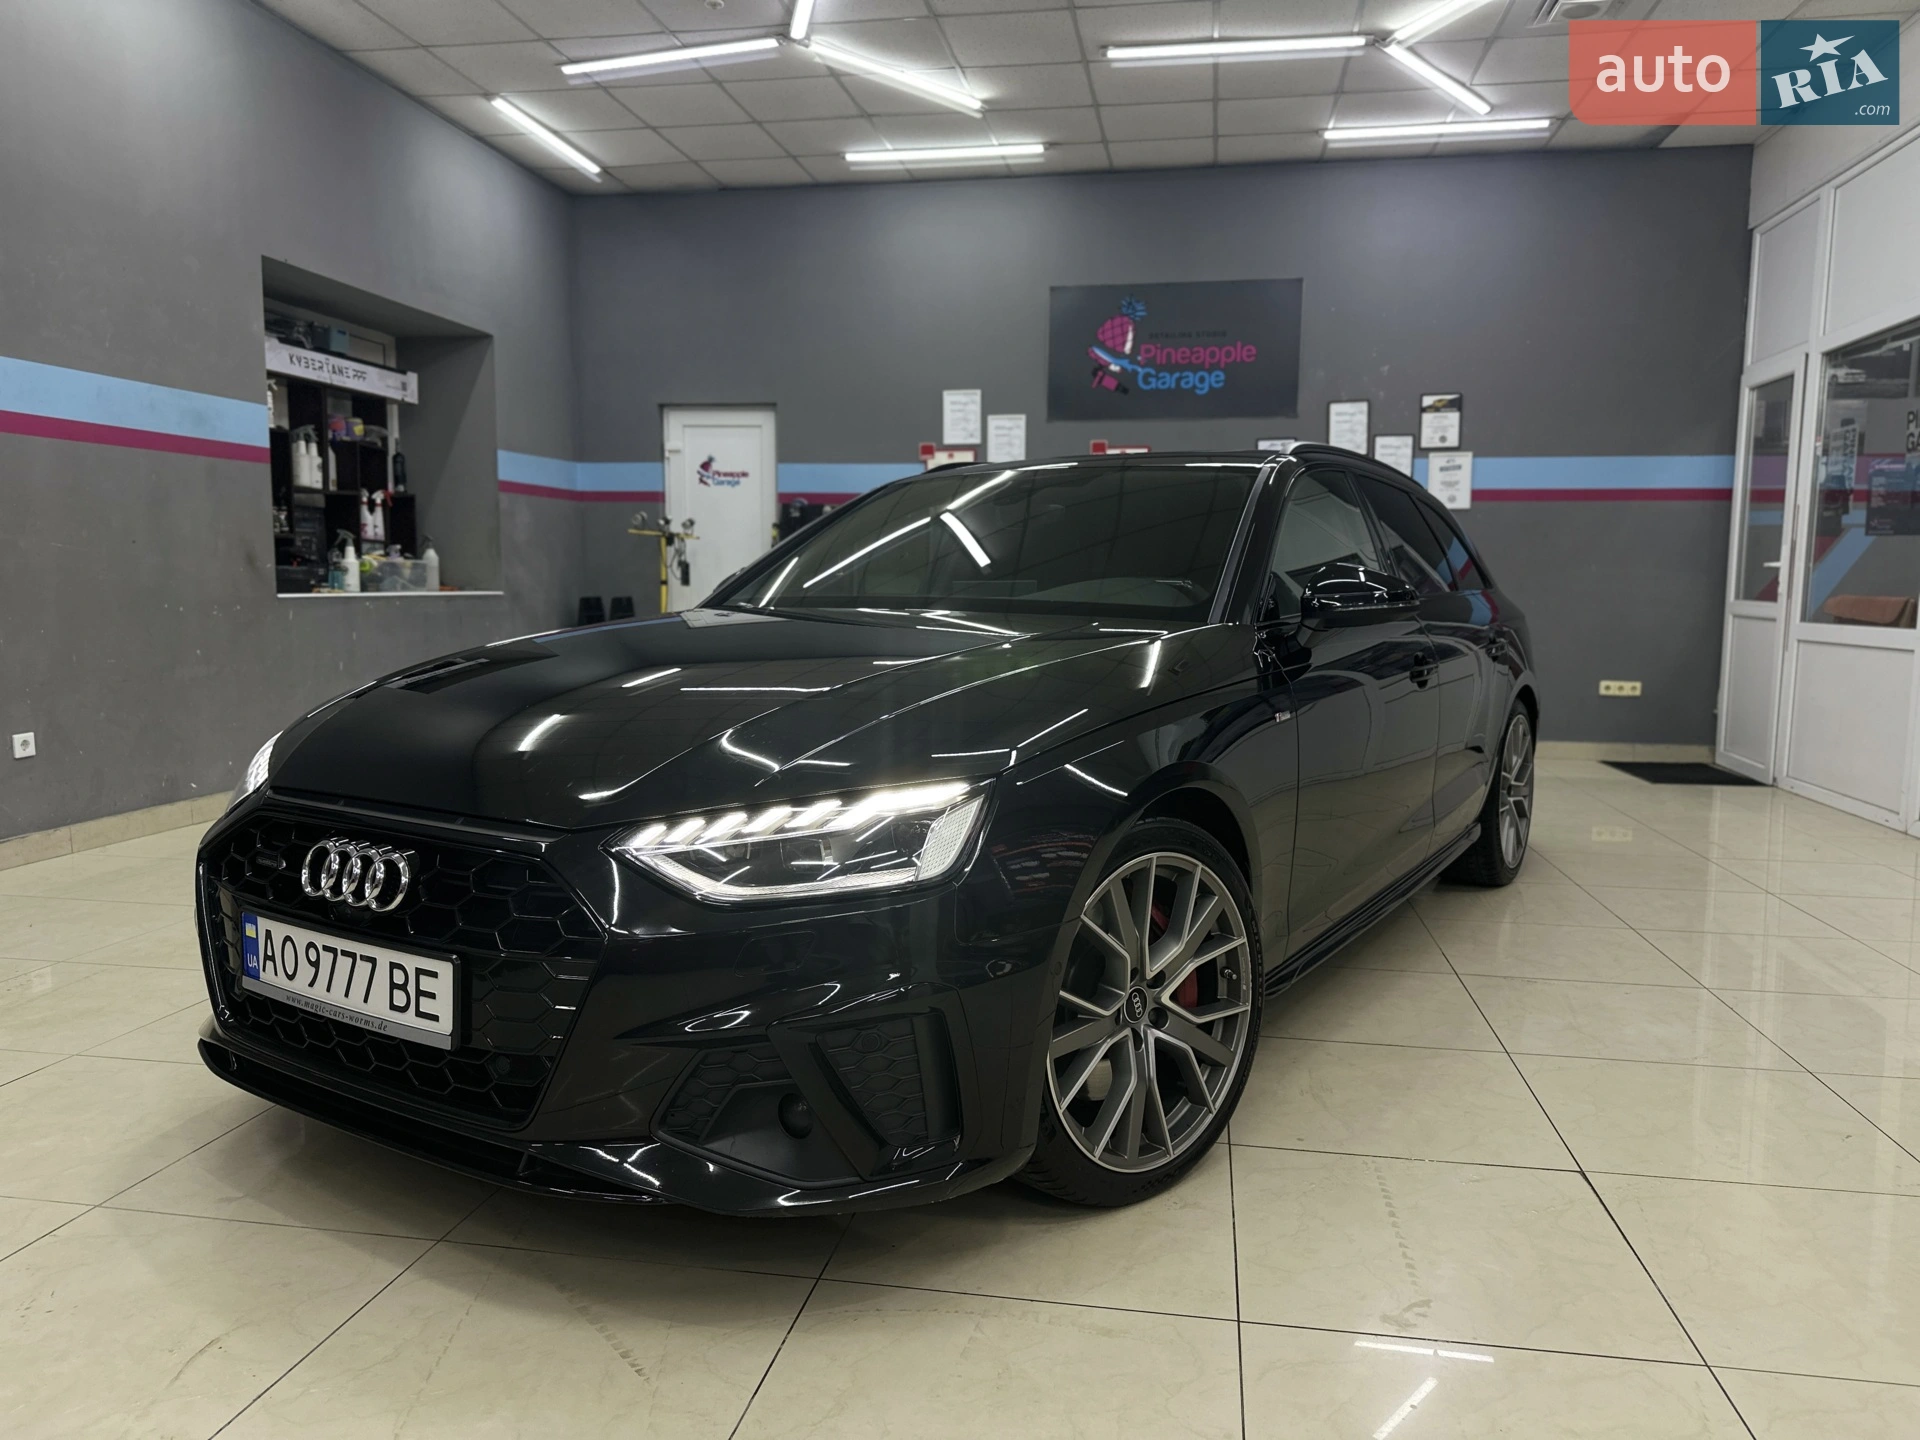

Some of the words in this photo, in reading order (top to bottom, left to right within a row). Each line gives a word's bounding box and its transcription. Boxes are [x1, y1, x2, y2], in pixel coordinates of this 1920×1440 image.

[1139, 340, 1257, 369] Pineapple
[1137, 367, 1226, 396] Garage
[712, 470, 749, 479] Pineapple
[713, 478, 741, 488] Garage
[247, 953, 259, 970] UA
[262, 928, 299, 981] AO
[305, 941, 378, 1004] 9777
[389, 961, 440, 1022] BE
[286, 994, 388, 1032] www.magic-cars-worms.de
